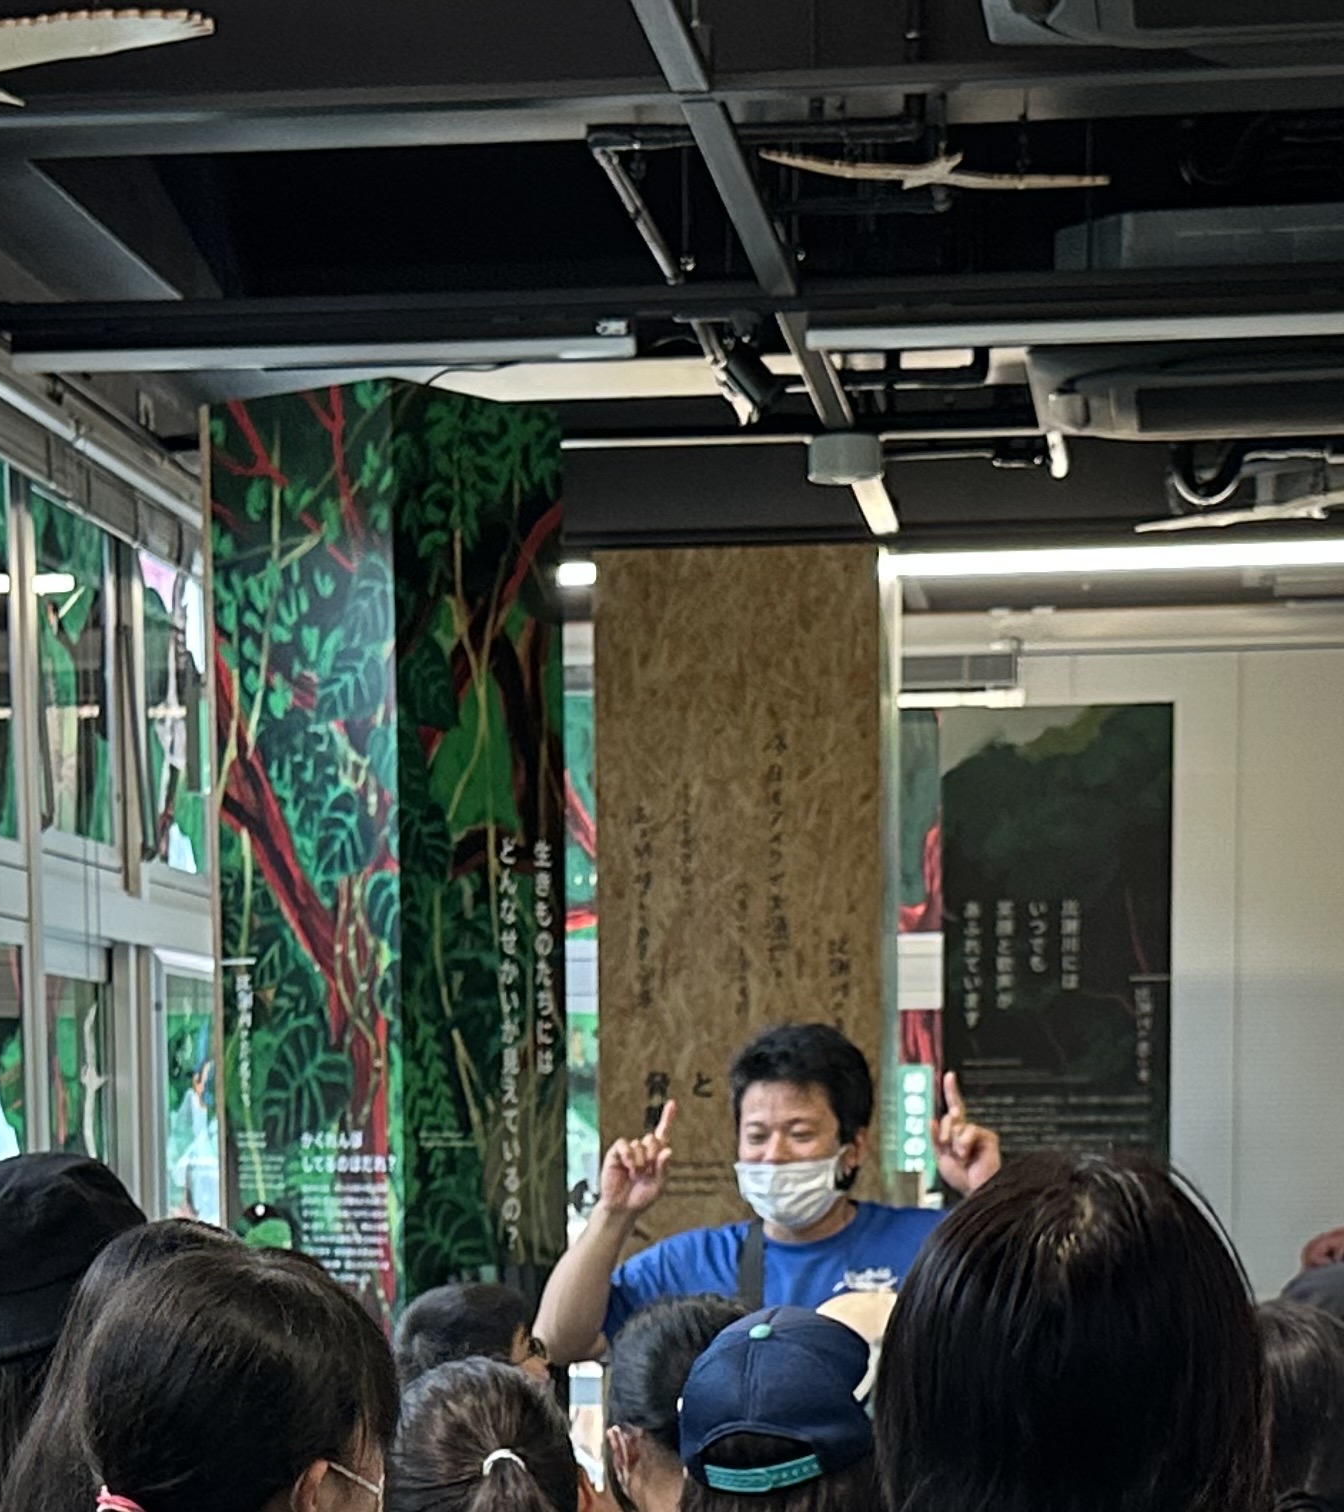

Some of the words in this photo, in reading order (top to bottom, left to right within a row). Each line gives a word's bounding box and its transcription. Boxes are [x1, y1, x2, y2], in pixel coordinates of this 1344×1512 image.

[499, 838, 520, 1249] どんなせかいが見えているの?
[534, 839, 554, 1074] 生きものたちには
